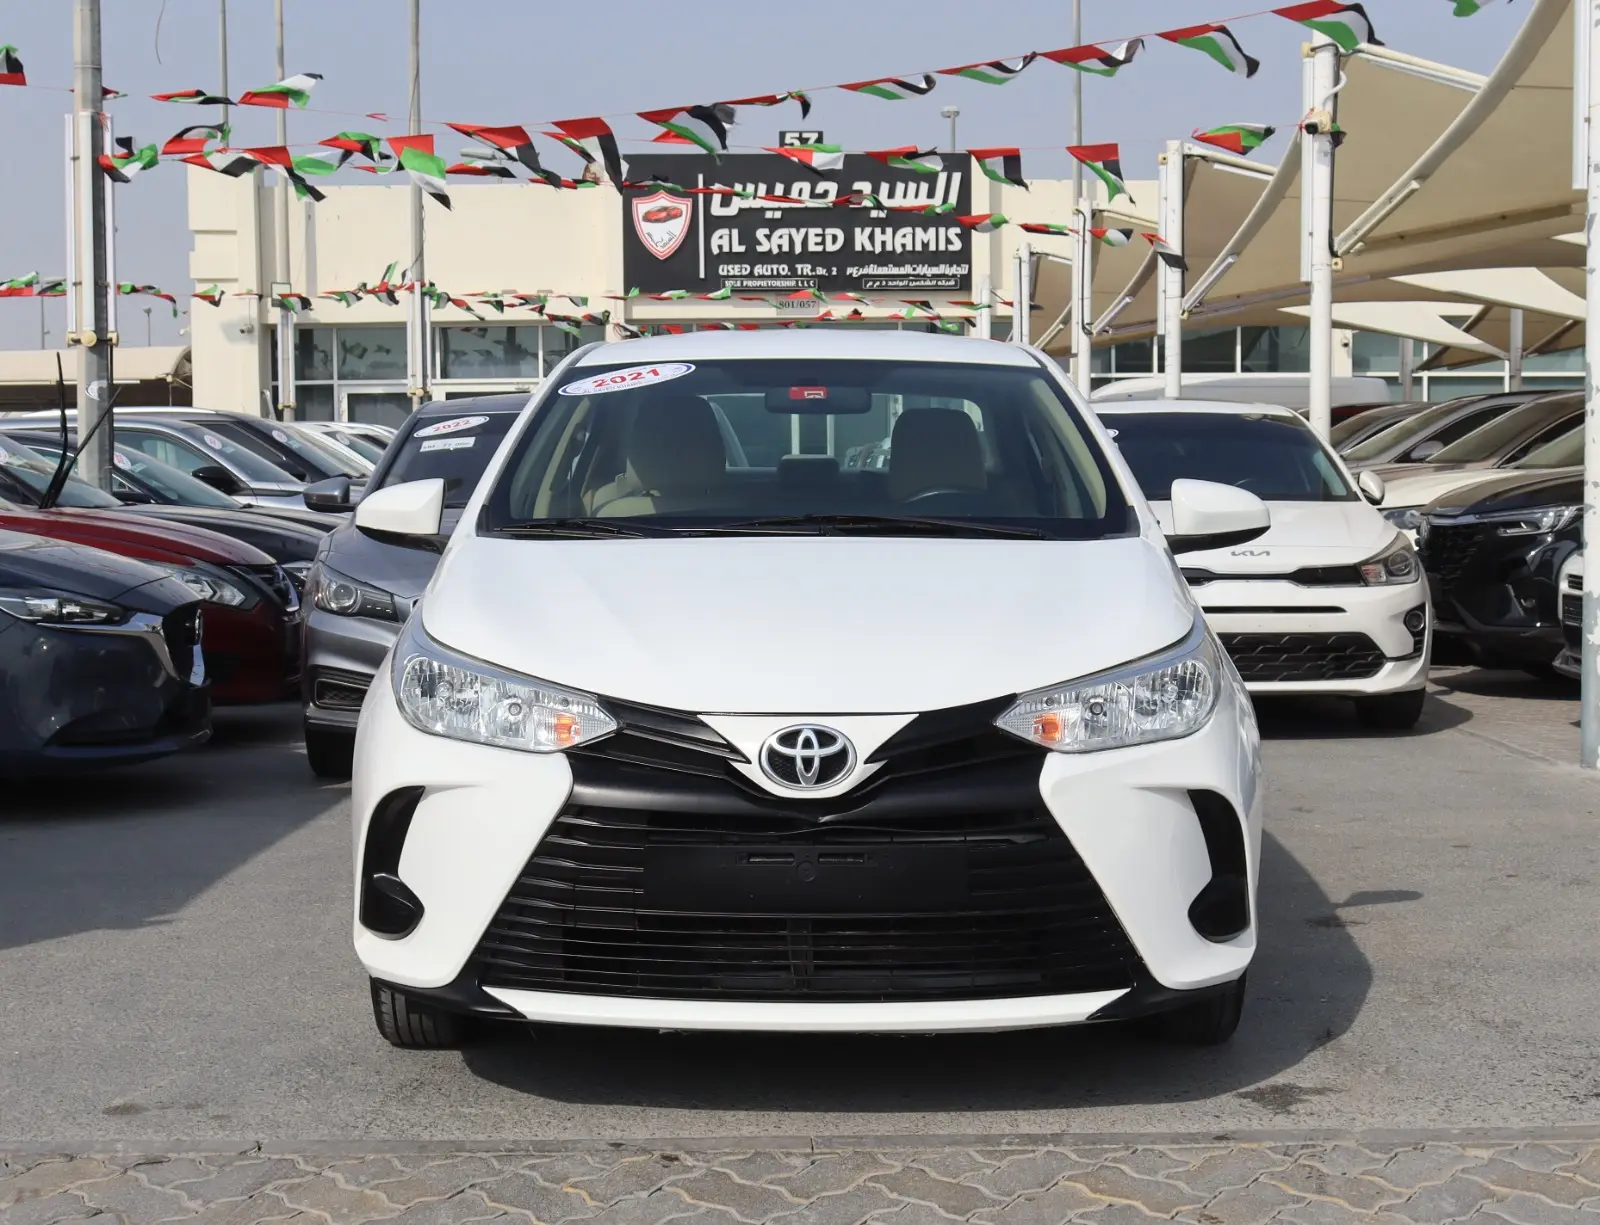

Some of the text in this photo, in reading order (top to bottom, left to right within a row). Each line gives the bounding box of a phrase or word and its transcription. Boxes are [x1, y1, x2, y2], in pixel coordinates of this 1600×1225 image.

[784, 132, 819, 147] 57
[711, 227, 963, 255] AL SAYED KHAMIS
[718, 264, 751, 276] USED
[753, 264, 791, 276] AUTO.
[592, 368, 660, 388] 2021
[433, 420, 472, 432] 2022
